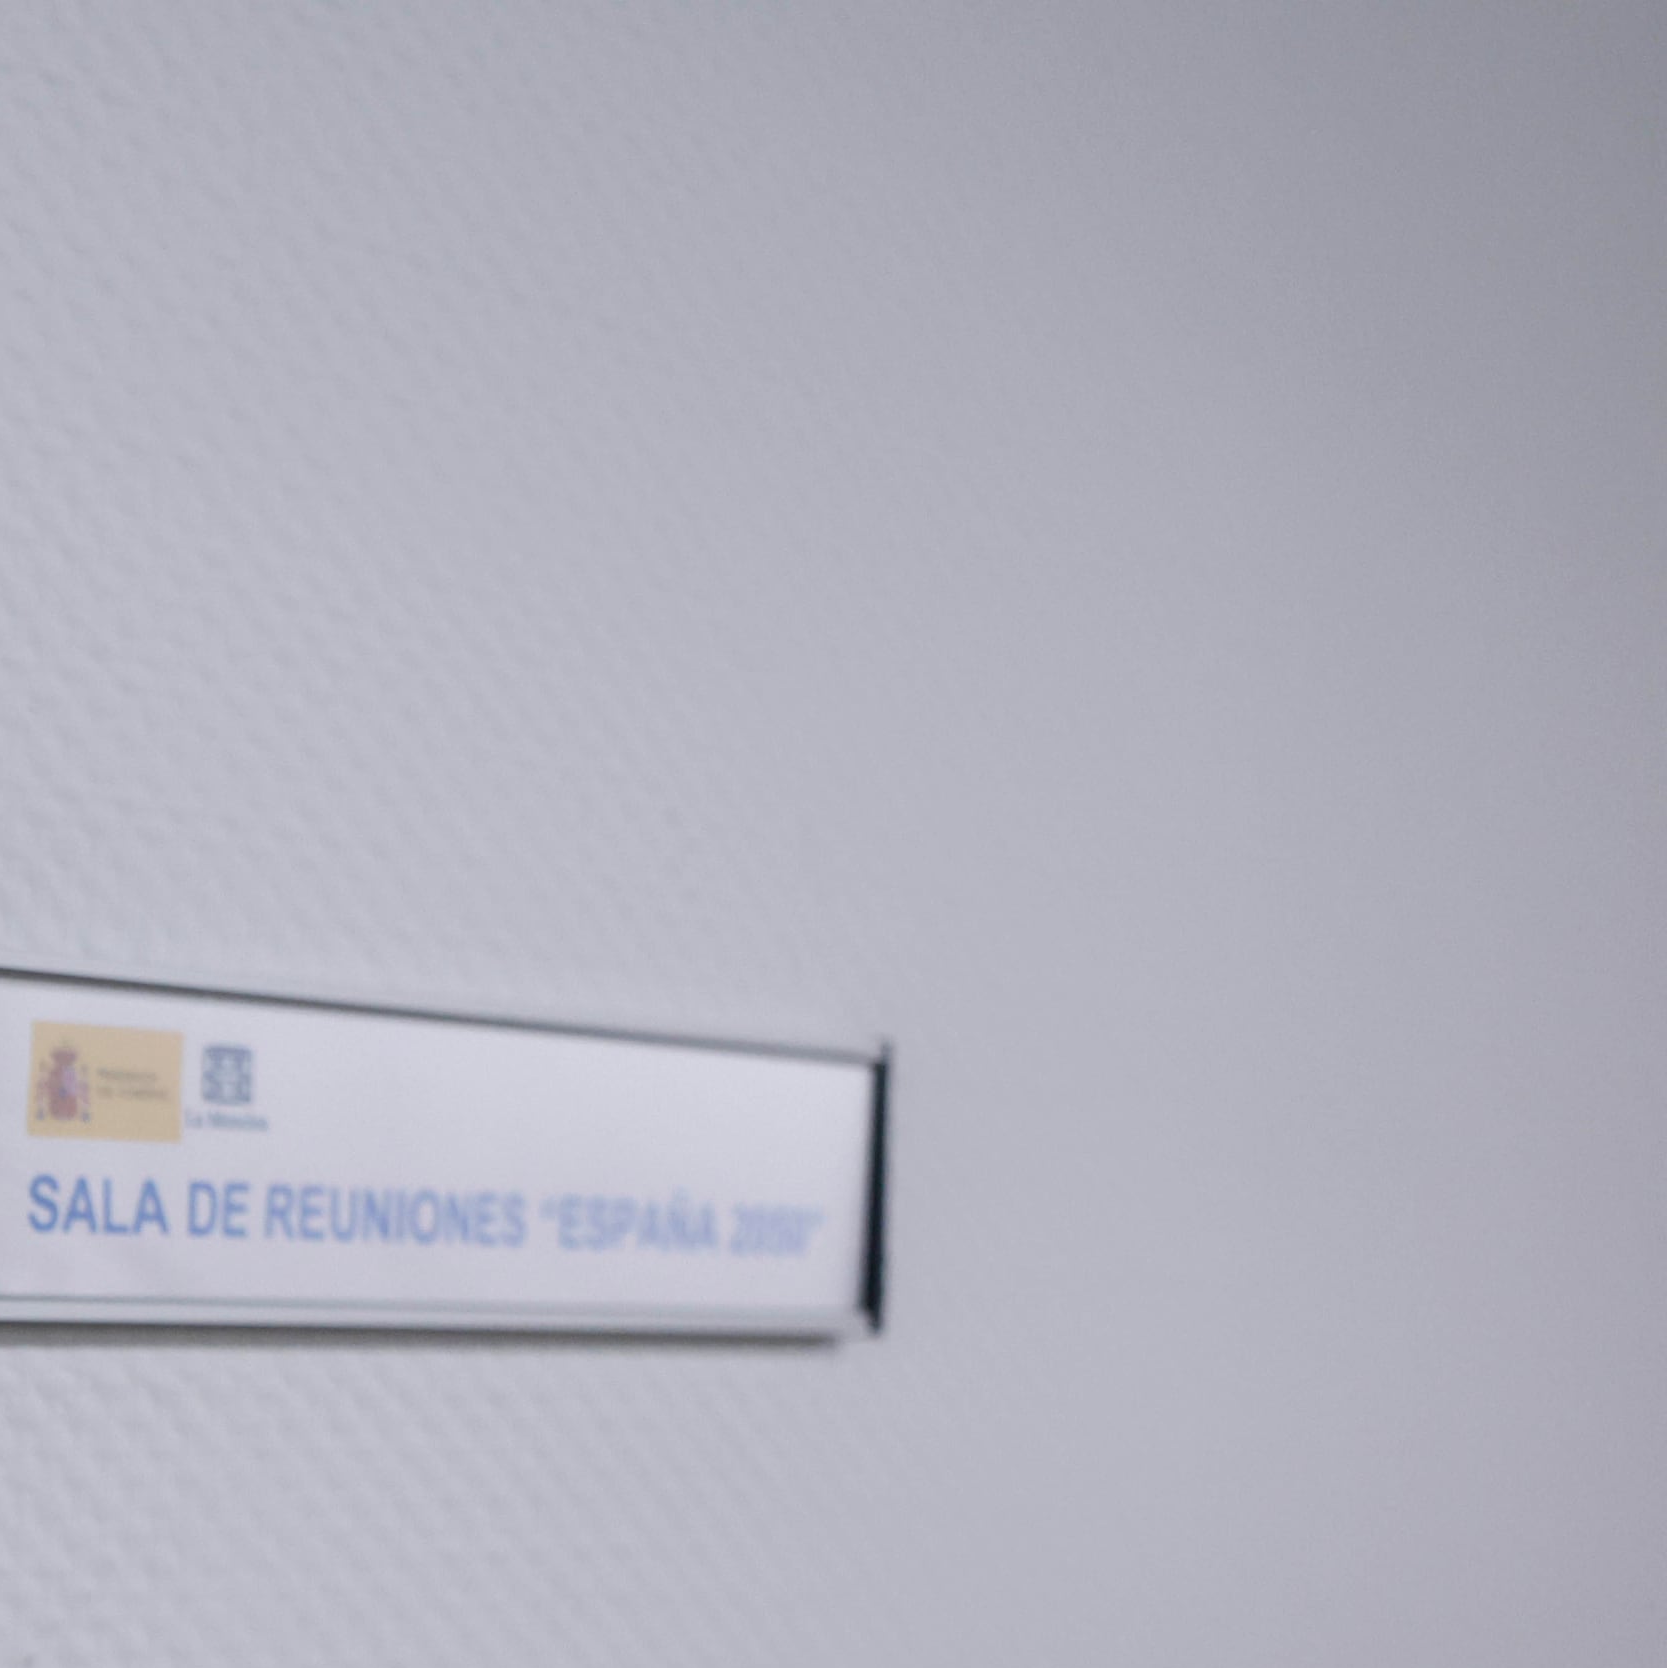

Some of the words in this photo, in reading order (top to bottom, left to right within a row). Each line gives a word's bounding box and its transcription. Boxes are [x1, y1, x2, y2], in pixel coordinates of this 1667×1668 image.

[28, 1173, 169, 1236] SALA
[186, 1180, 252, 1238] DE
[264, 1183, 526, 1248] REUNIONES
